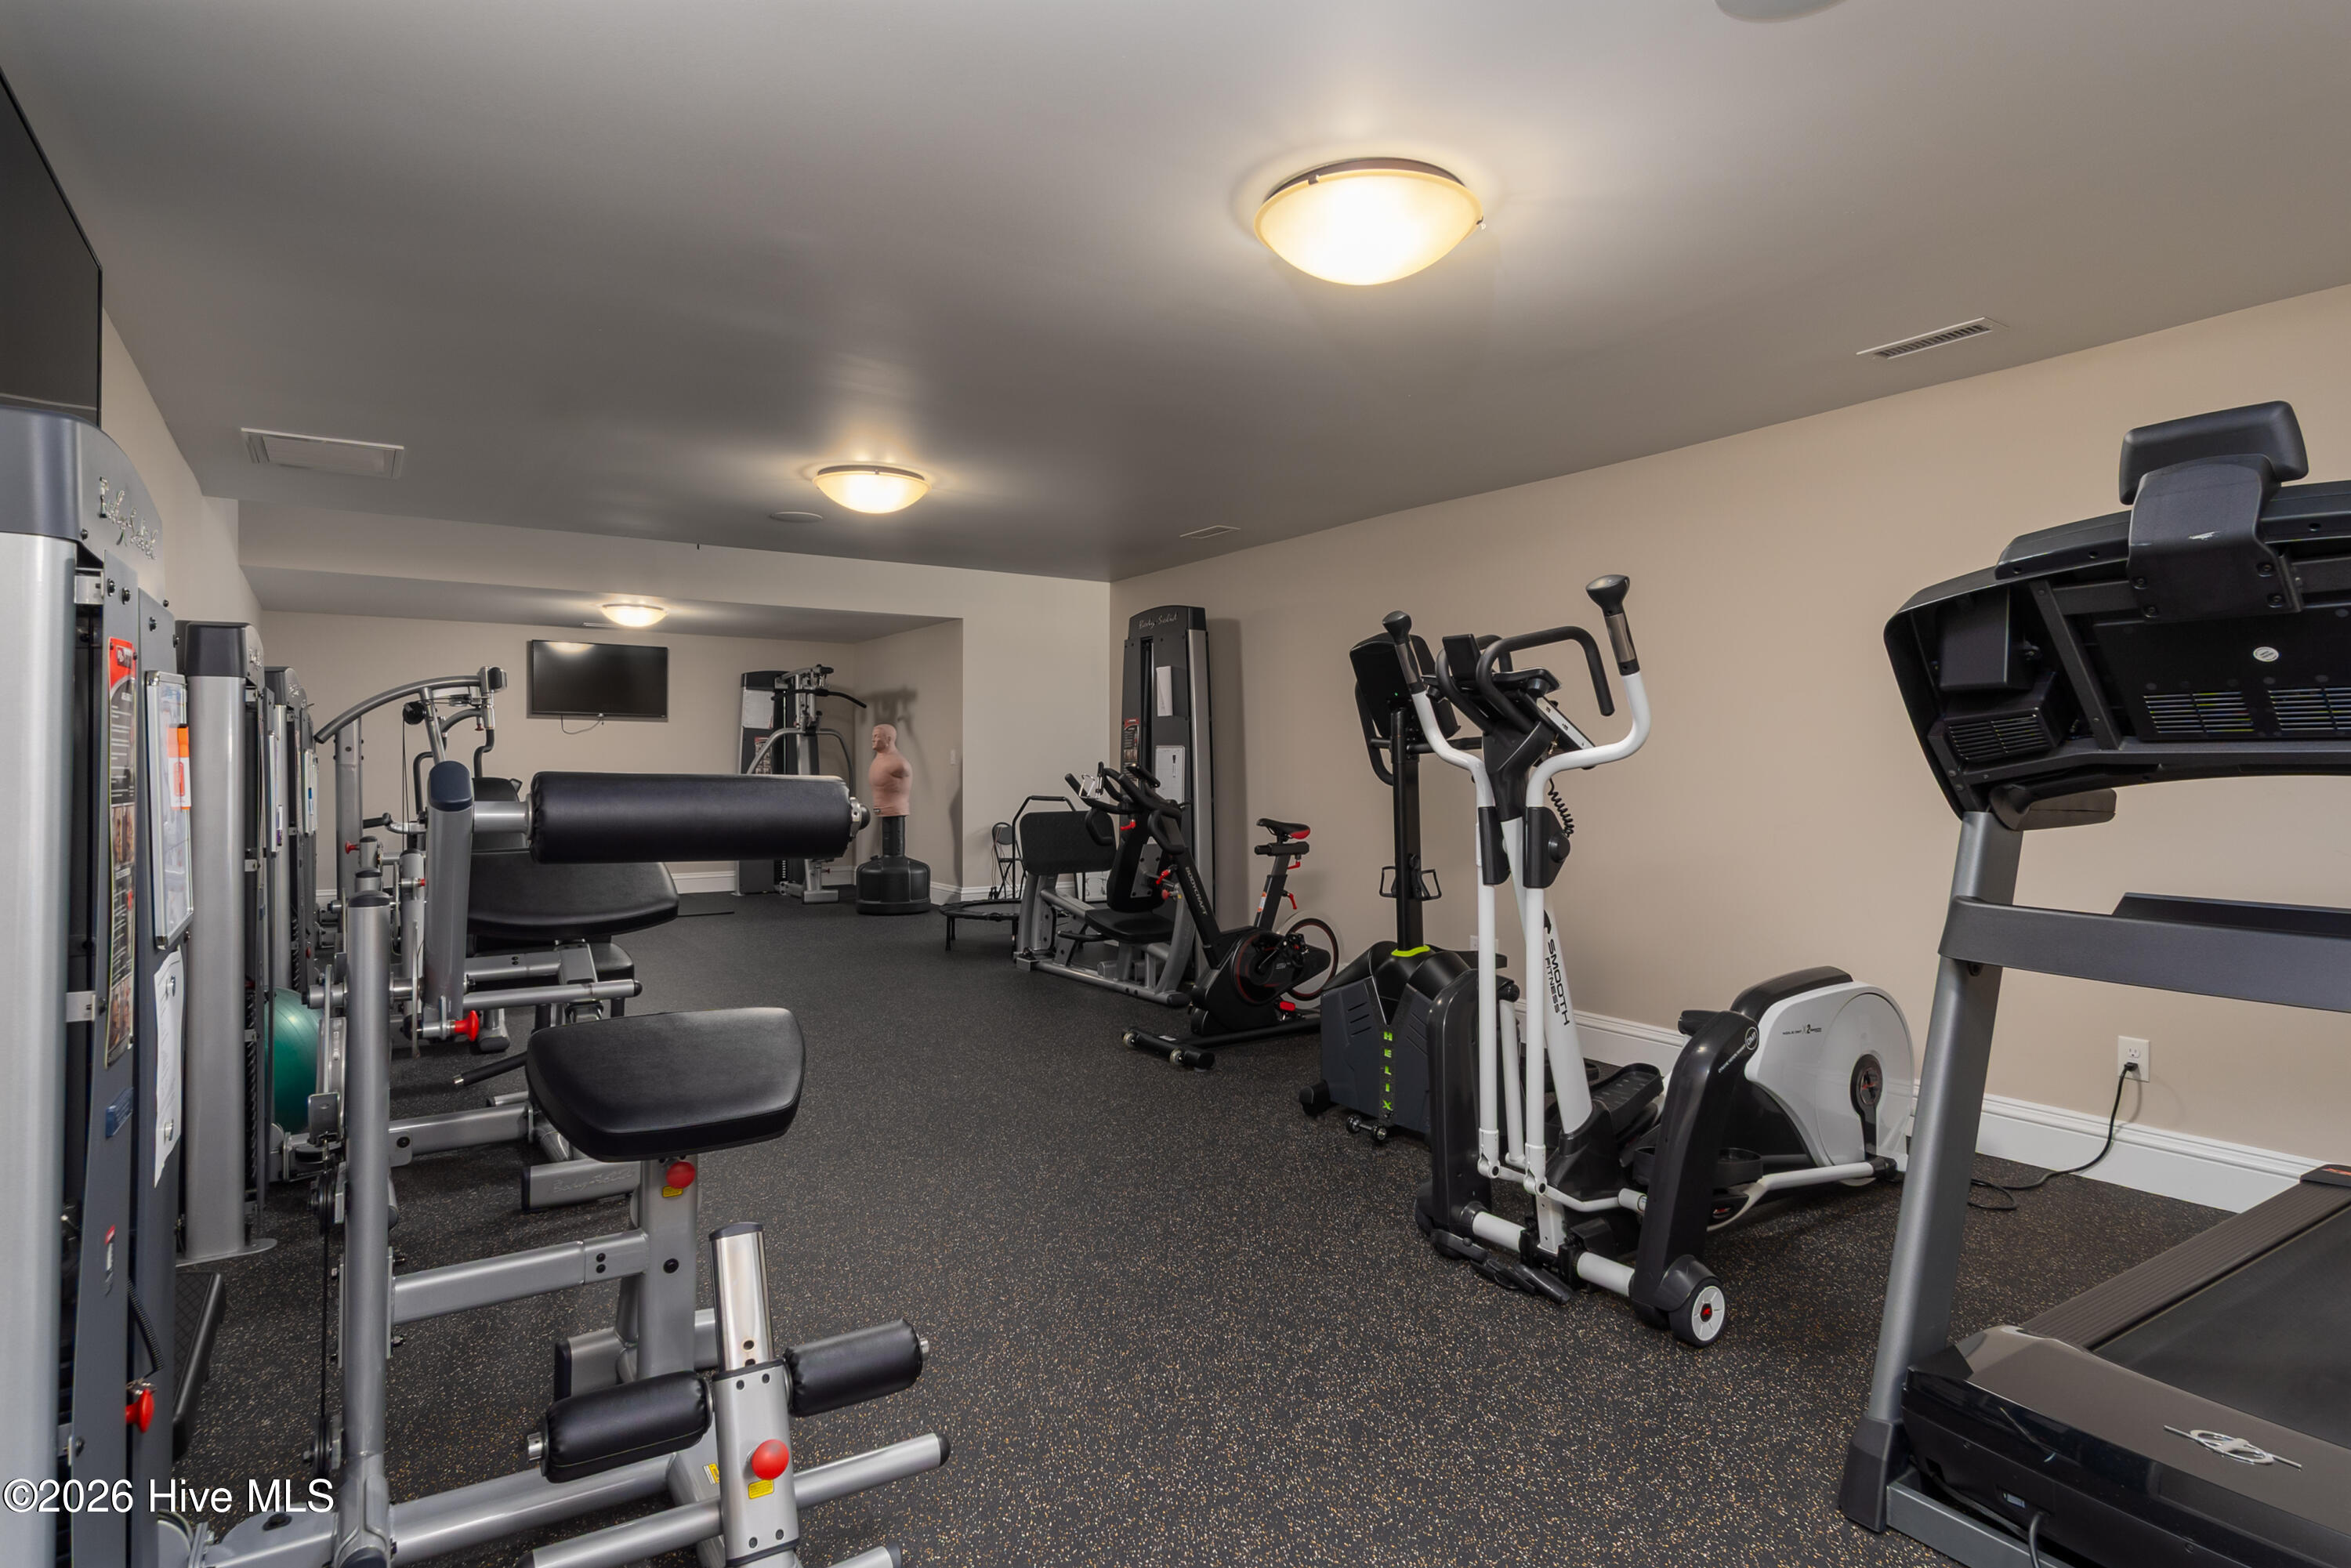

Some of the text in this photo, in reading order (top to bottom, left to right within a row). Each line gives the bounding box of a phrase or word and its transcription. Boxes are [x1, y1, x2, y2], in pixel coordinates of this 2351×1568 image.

[1185, 866, 1208, 915] BODYCRAFT
[1545, 957, 1560, 1013] FITNESS
[1548, 939, 1570, 1026] SMOOTH
[1382, 1030, 1393, 1111] HELIX
